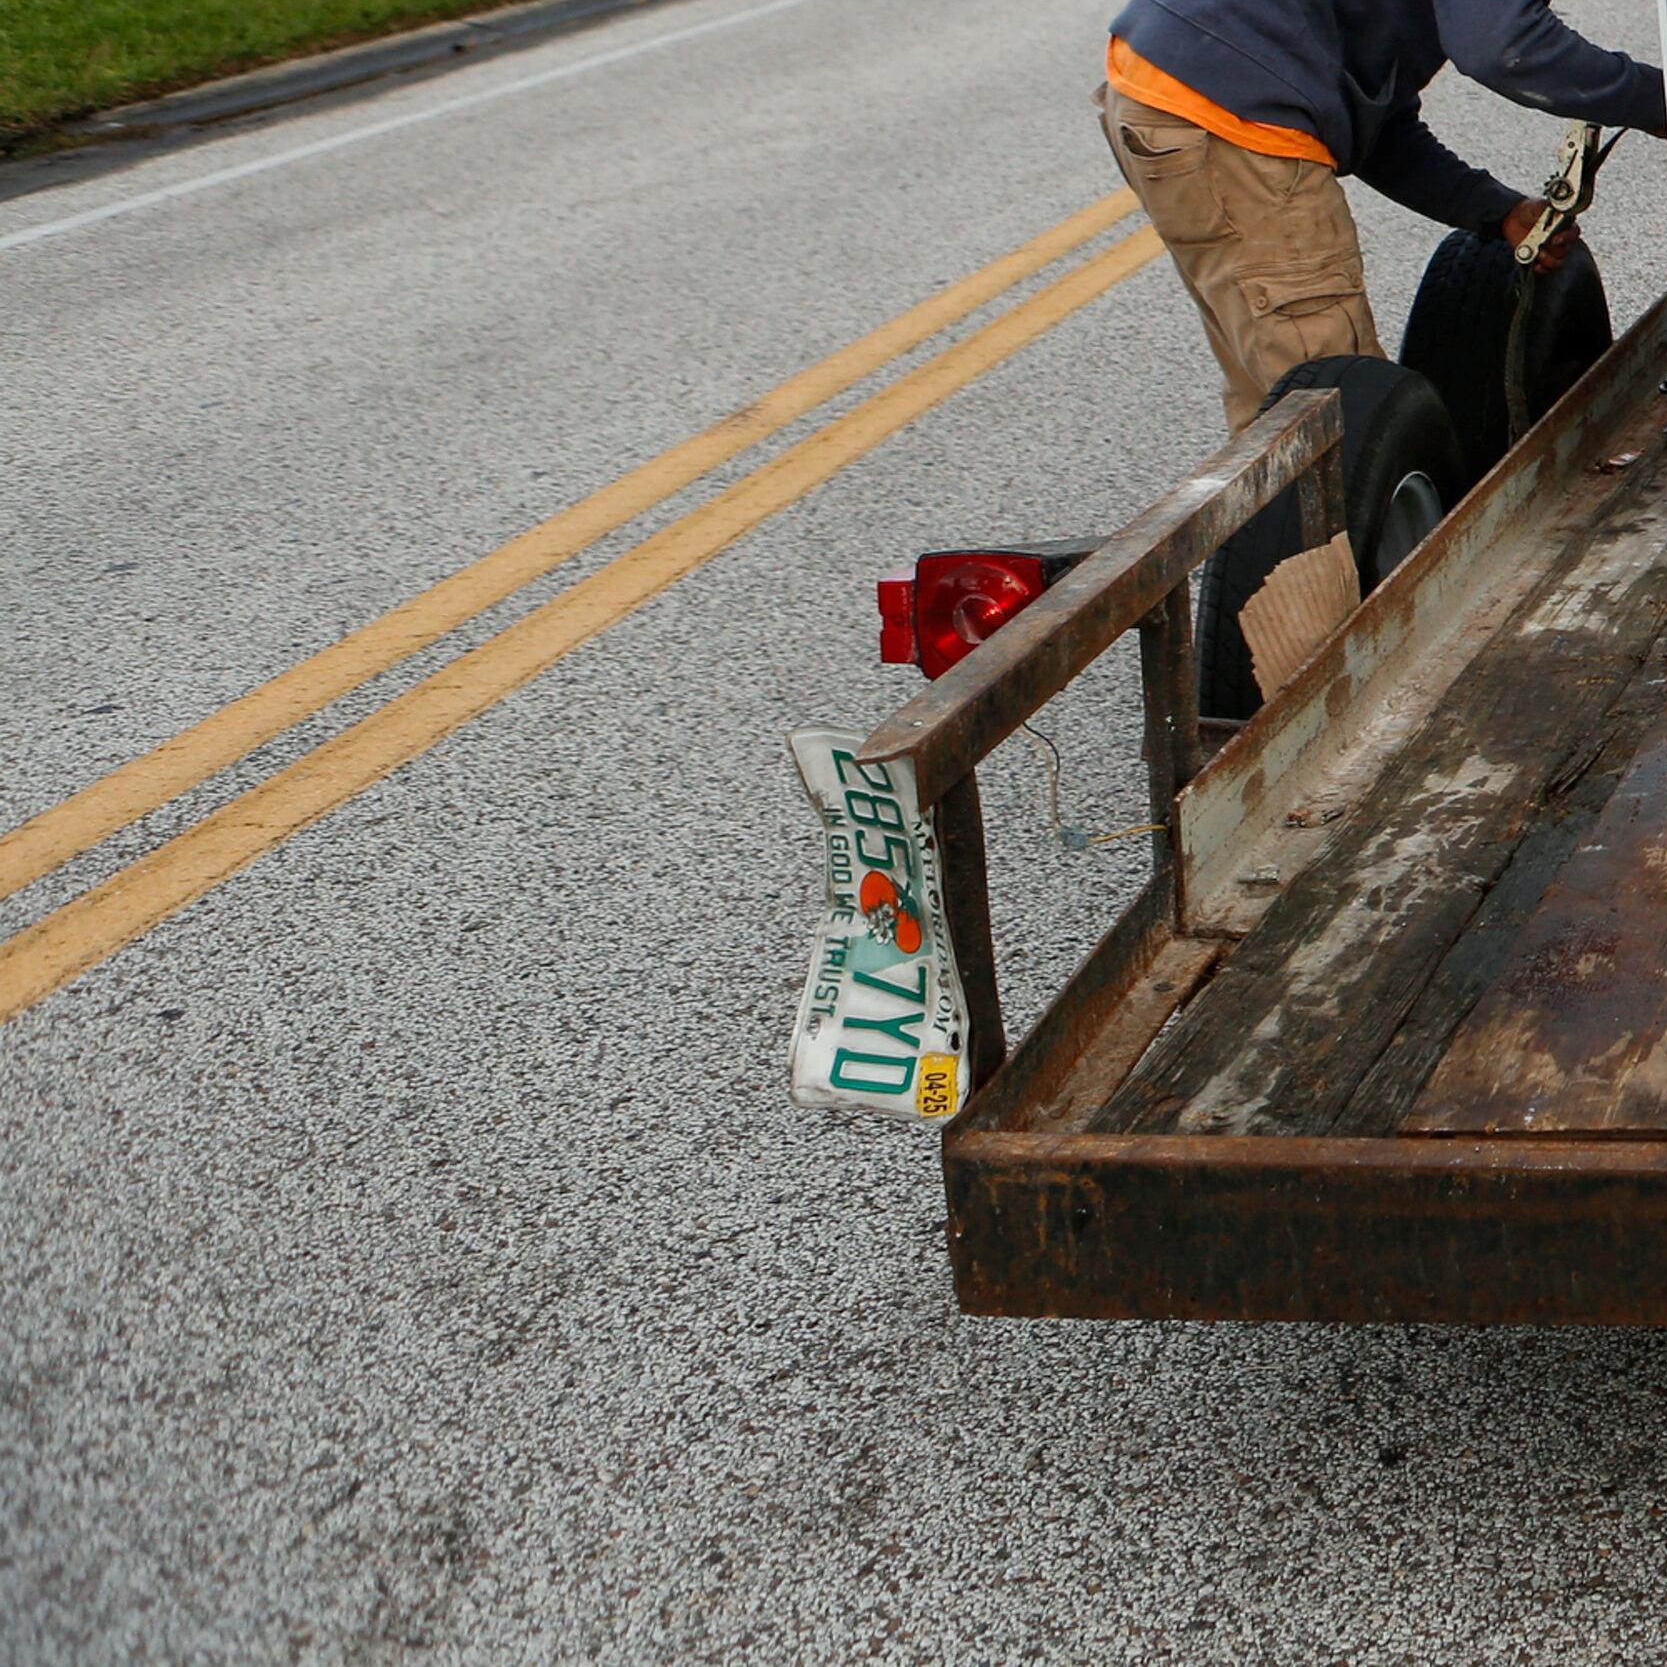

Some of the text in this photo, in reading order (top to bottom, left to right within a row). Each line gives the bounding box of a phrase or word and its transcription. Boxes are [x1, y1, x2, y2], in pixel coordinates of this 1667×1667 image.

[811, 807, 857, 1018] IN GOD WE TRUST
[829, 749, 926, 1095] 285 7YD
[911, 820, 953, 1034] MYFLORIDAOM
[923, 1072, 947, 1113] 04-25
